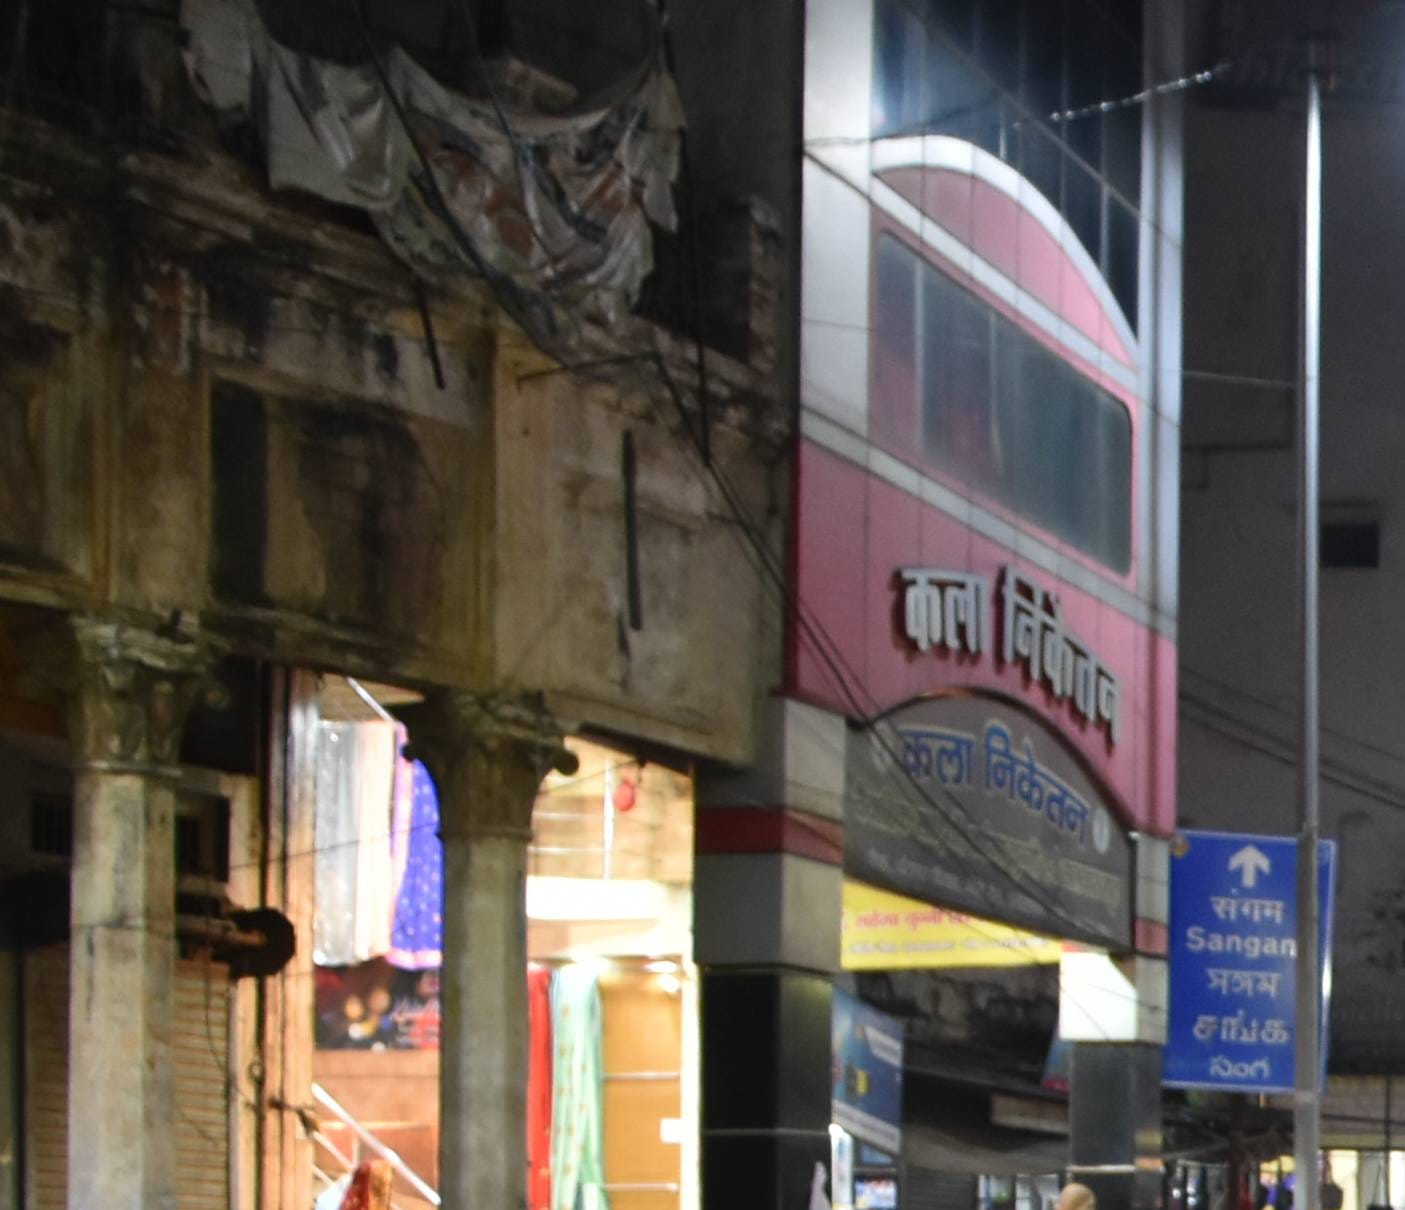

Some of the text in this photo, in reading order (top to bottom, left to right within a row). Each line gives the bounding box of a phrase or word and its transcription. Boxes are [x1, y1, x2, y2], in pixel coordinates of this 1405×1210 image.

[901, 567, 989, 653] कला
[900, 724, 976, 788] कला
[983, 719, 1090, 845] निकेतन
[1210, 887, 1284, 924] संगम
